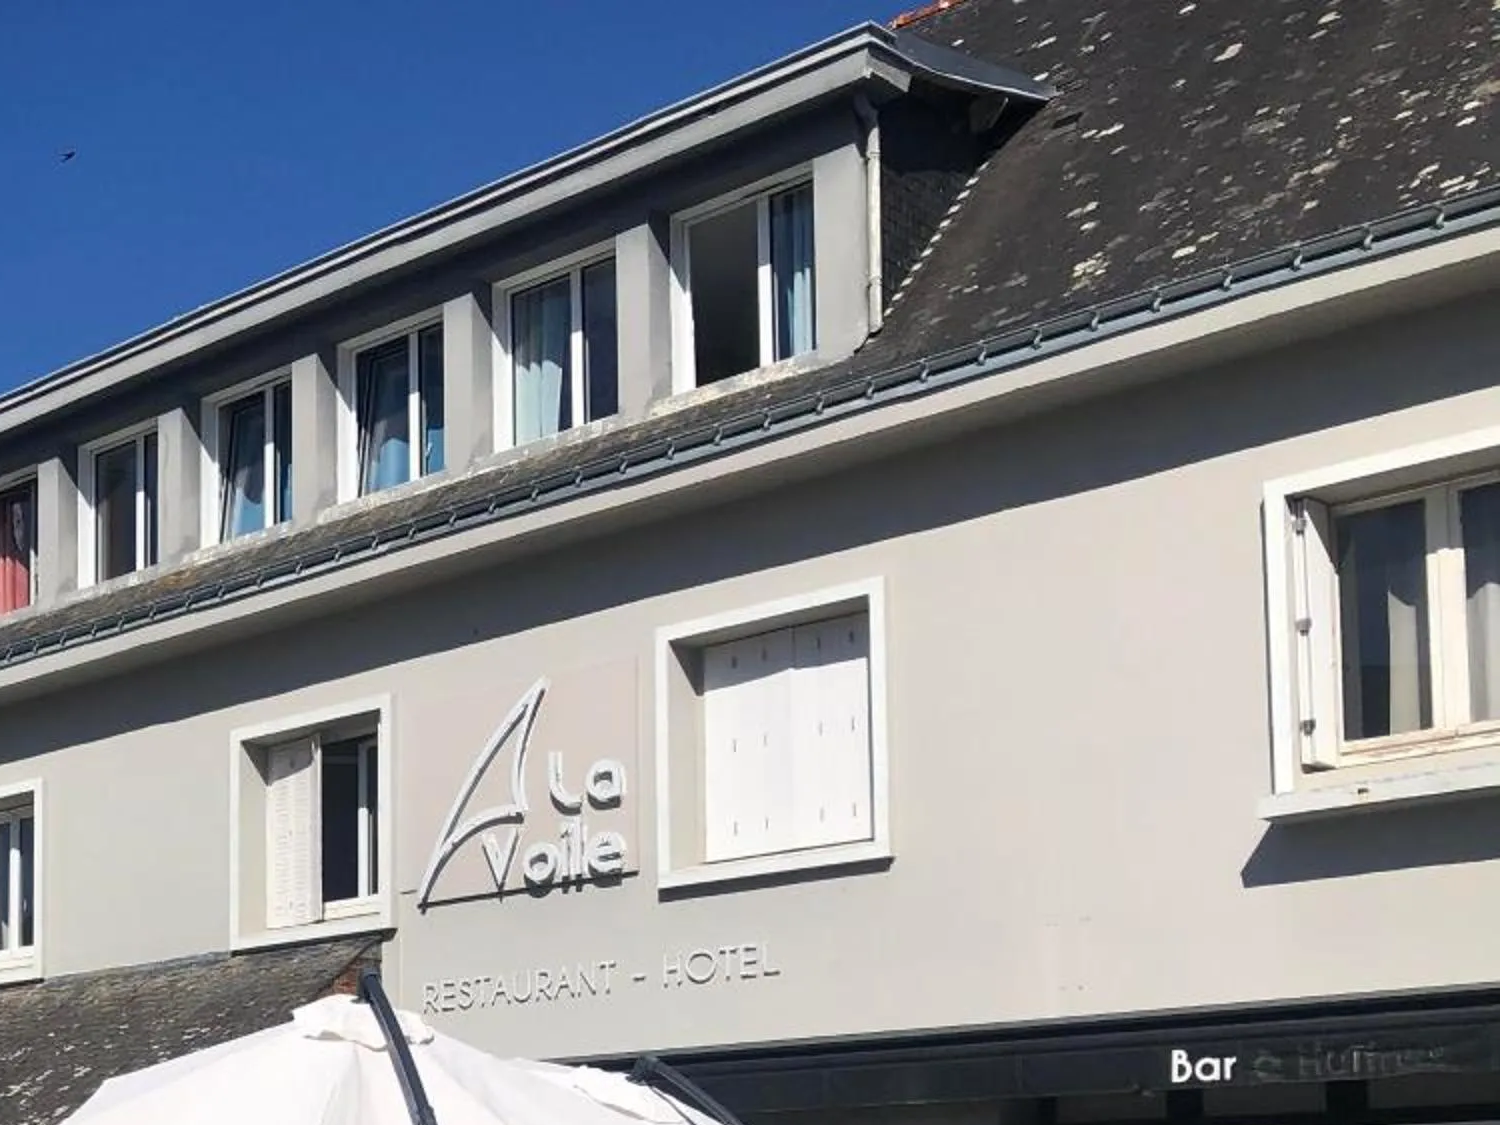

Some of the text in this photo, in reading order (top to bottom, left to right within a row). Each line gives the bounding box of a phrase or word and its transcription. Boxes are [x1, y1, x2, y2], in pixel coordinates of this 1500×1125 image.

[480, 818, 627, 898] Voile
[422, 959, 618, 1015] RESTAURANT
[1171, 1049, 1237, 1083] Bar
